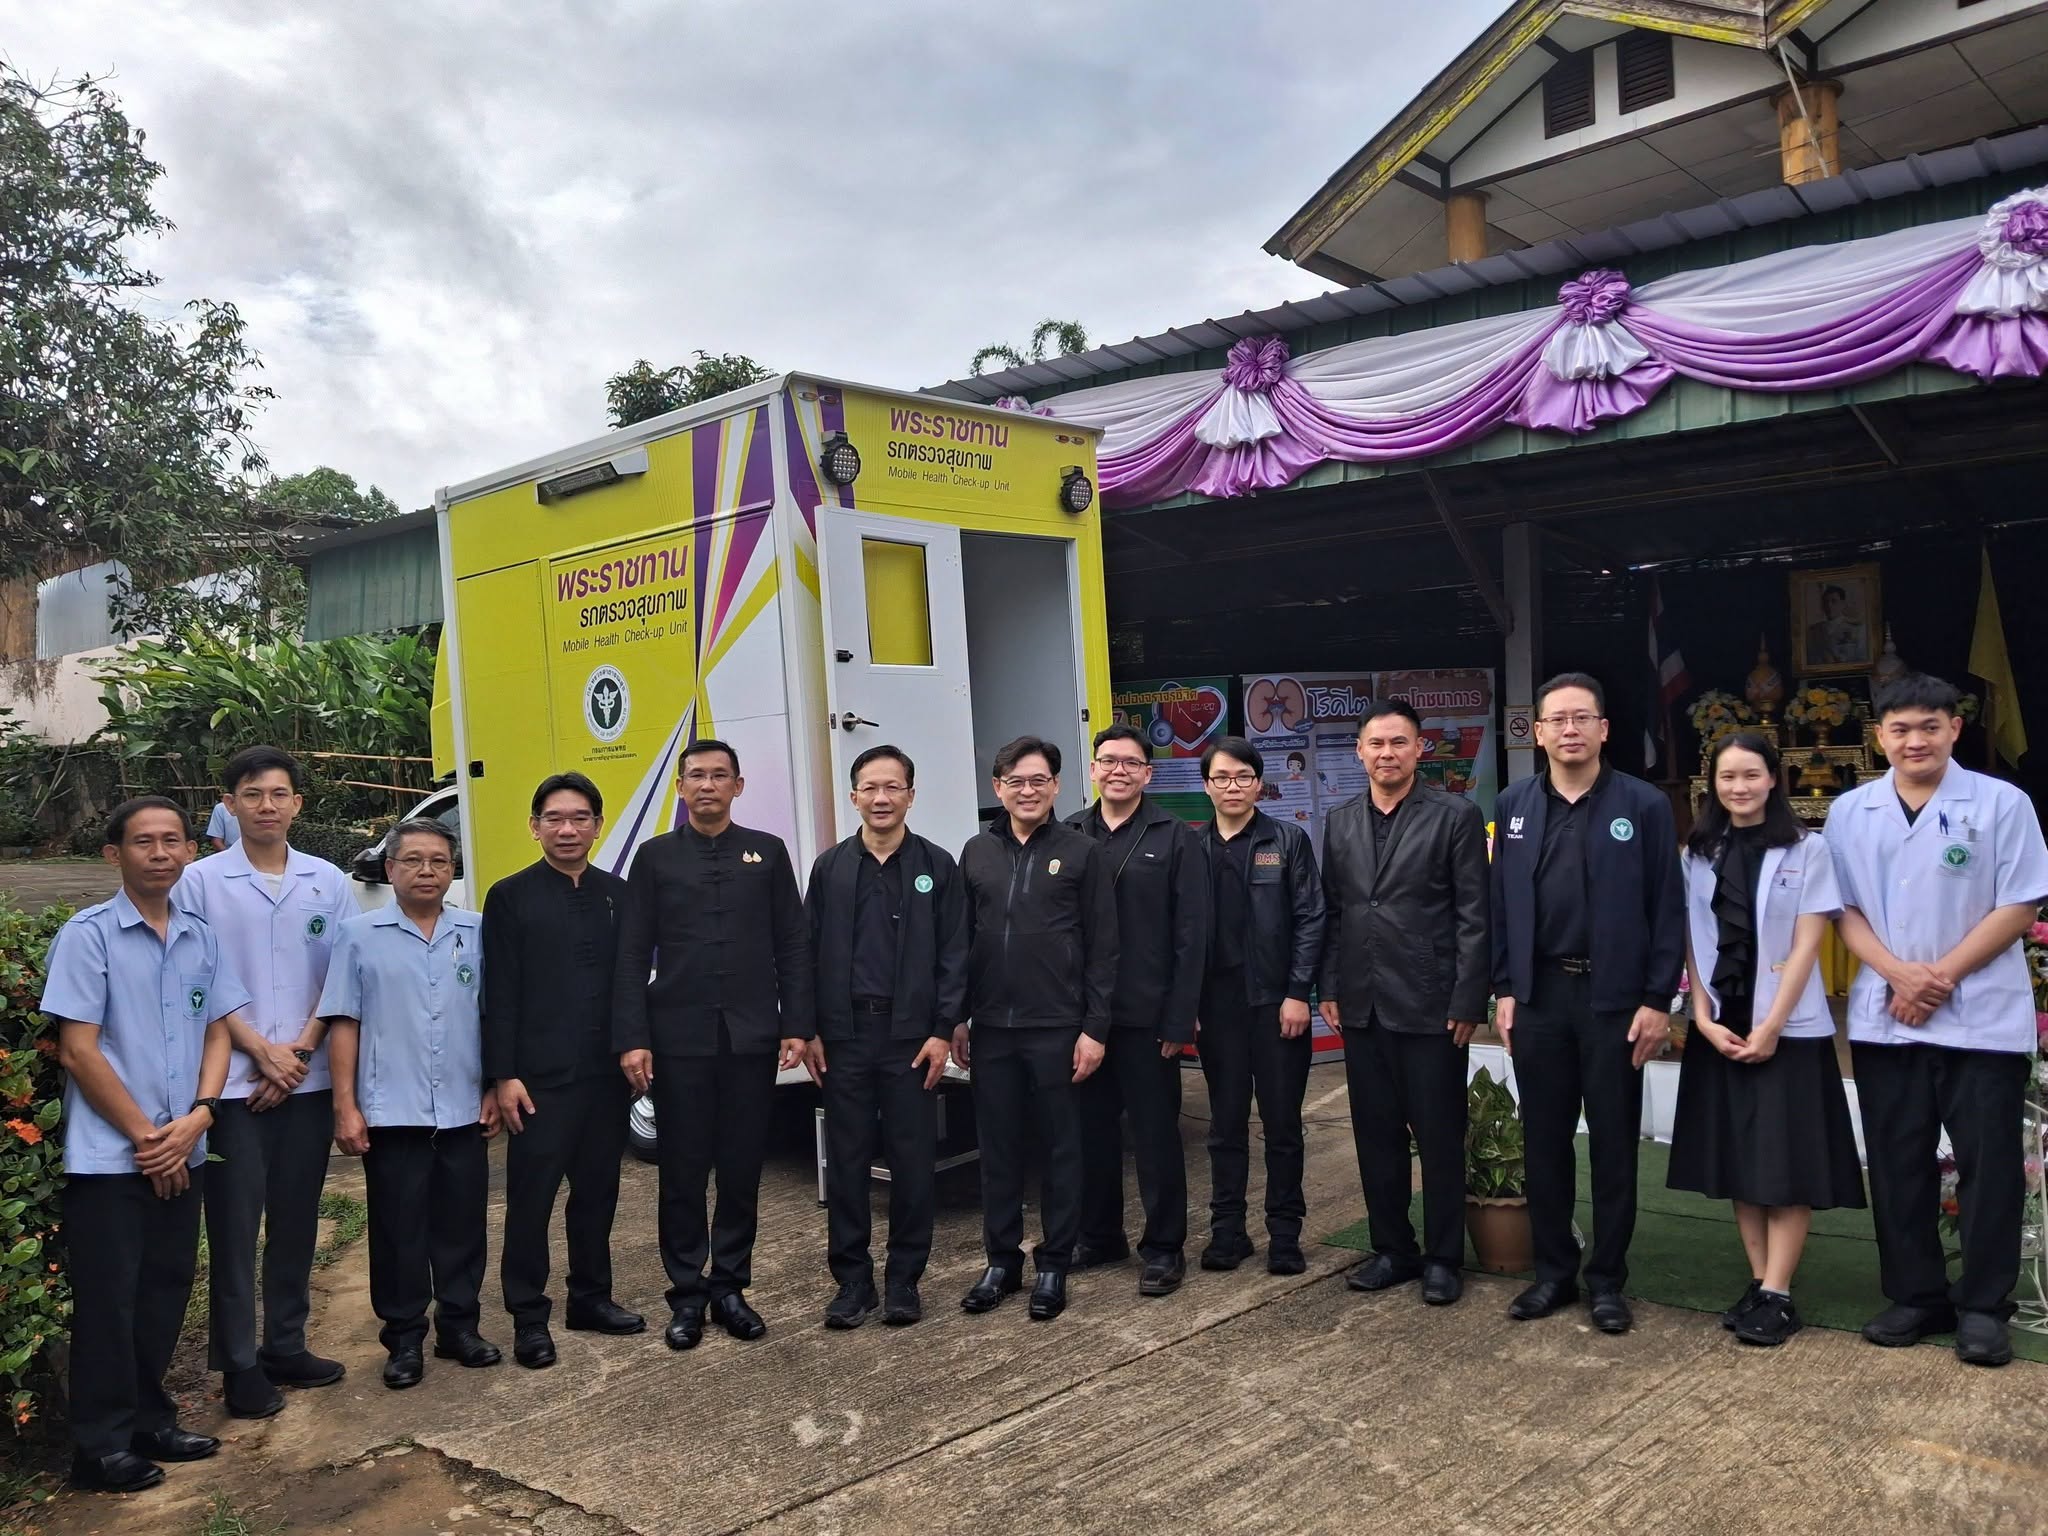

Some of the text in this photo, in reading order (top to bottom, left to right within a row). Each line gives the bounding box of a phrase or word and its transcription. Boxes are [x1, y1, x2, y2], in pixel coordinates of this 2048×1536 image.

[890, 408, 1009, 448] พระราชทาน
[887, 441, 992, 473] รถตรวจสุขภาพ
[888, 466, 1010, 491] Mobile Health Check-up Unit
[558, 545, 688, 602] พระราชทาน
[580, 588, 687, 627] รถตรวจสุขภาพ
[563, 620, 687, 653] Mobile Health Check-up Unit
[1255, 852, 1280, 863] DMS
